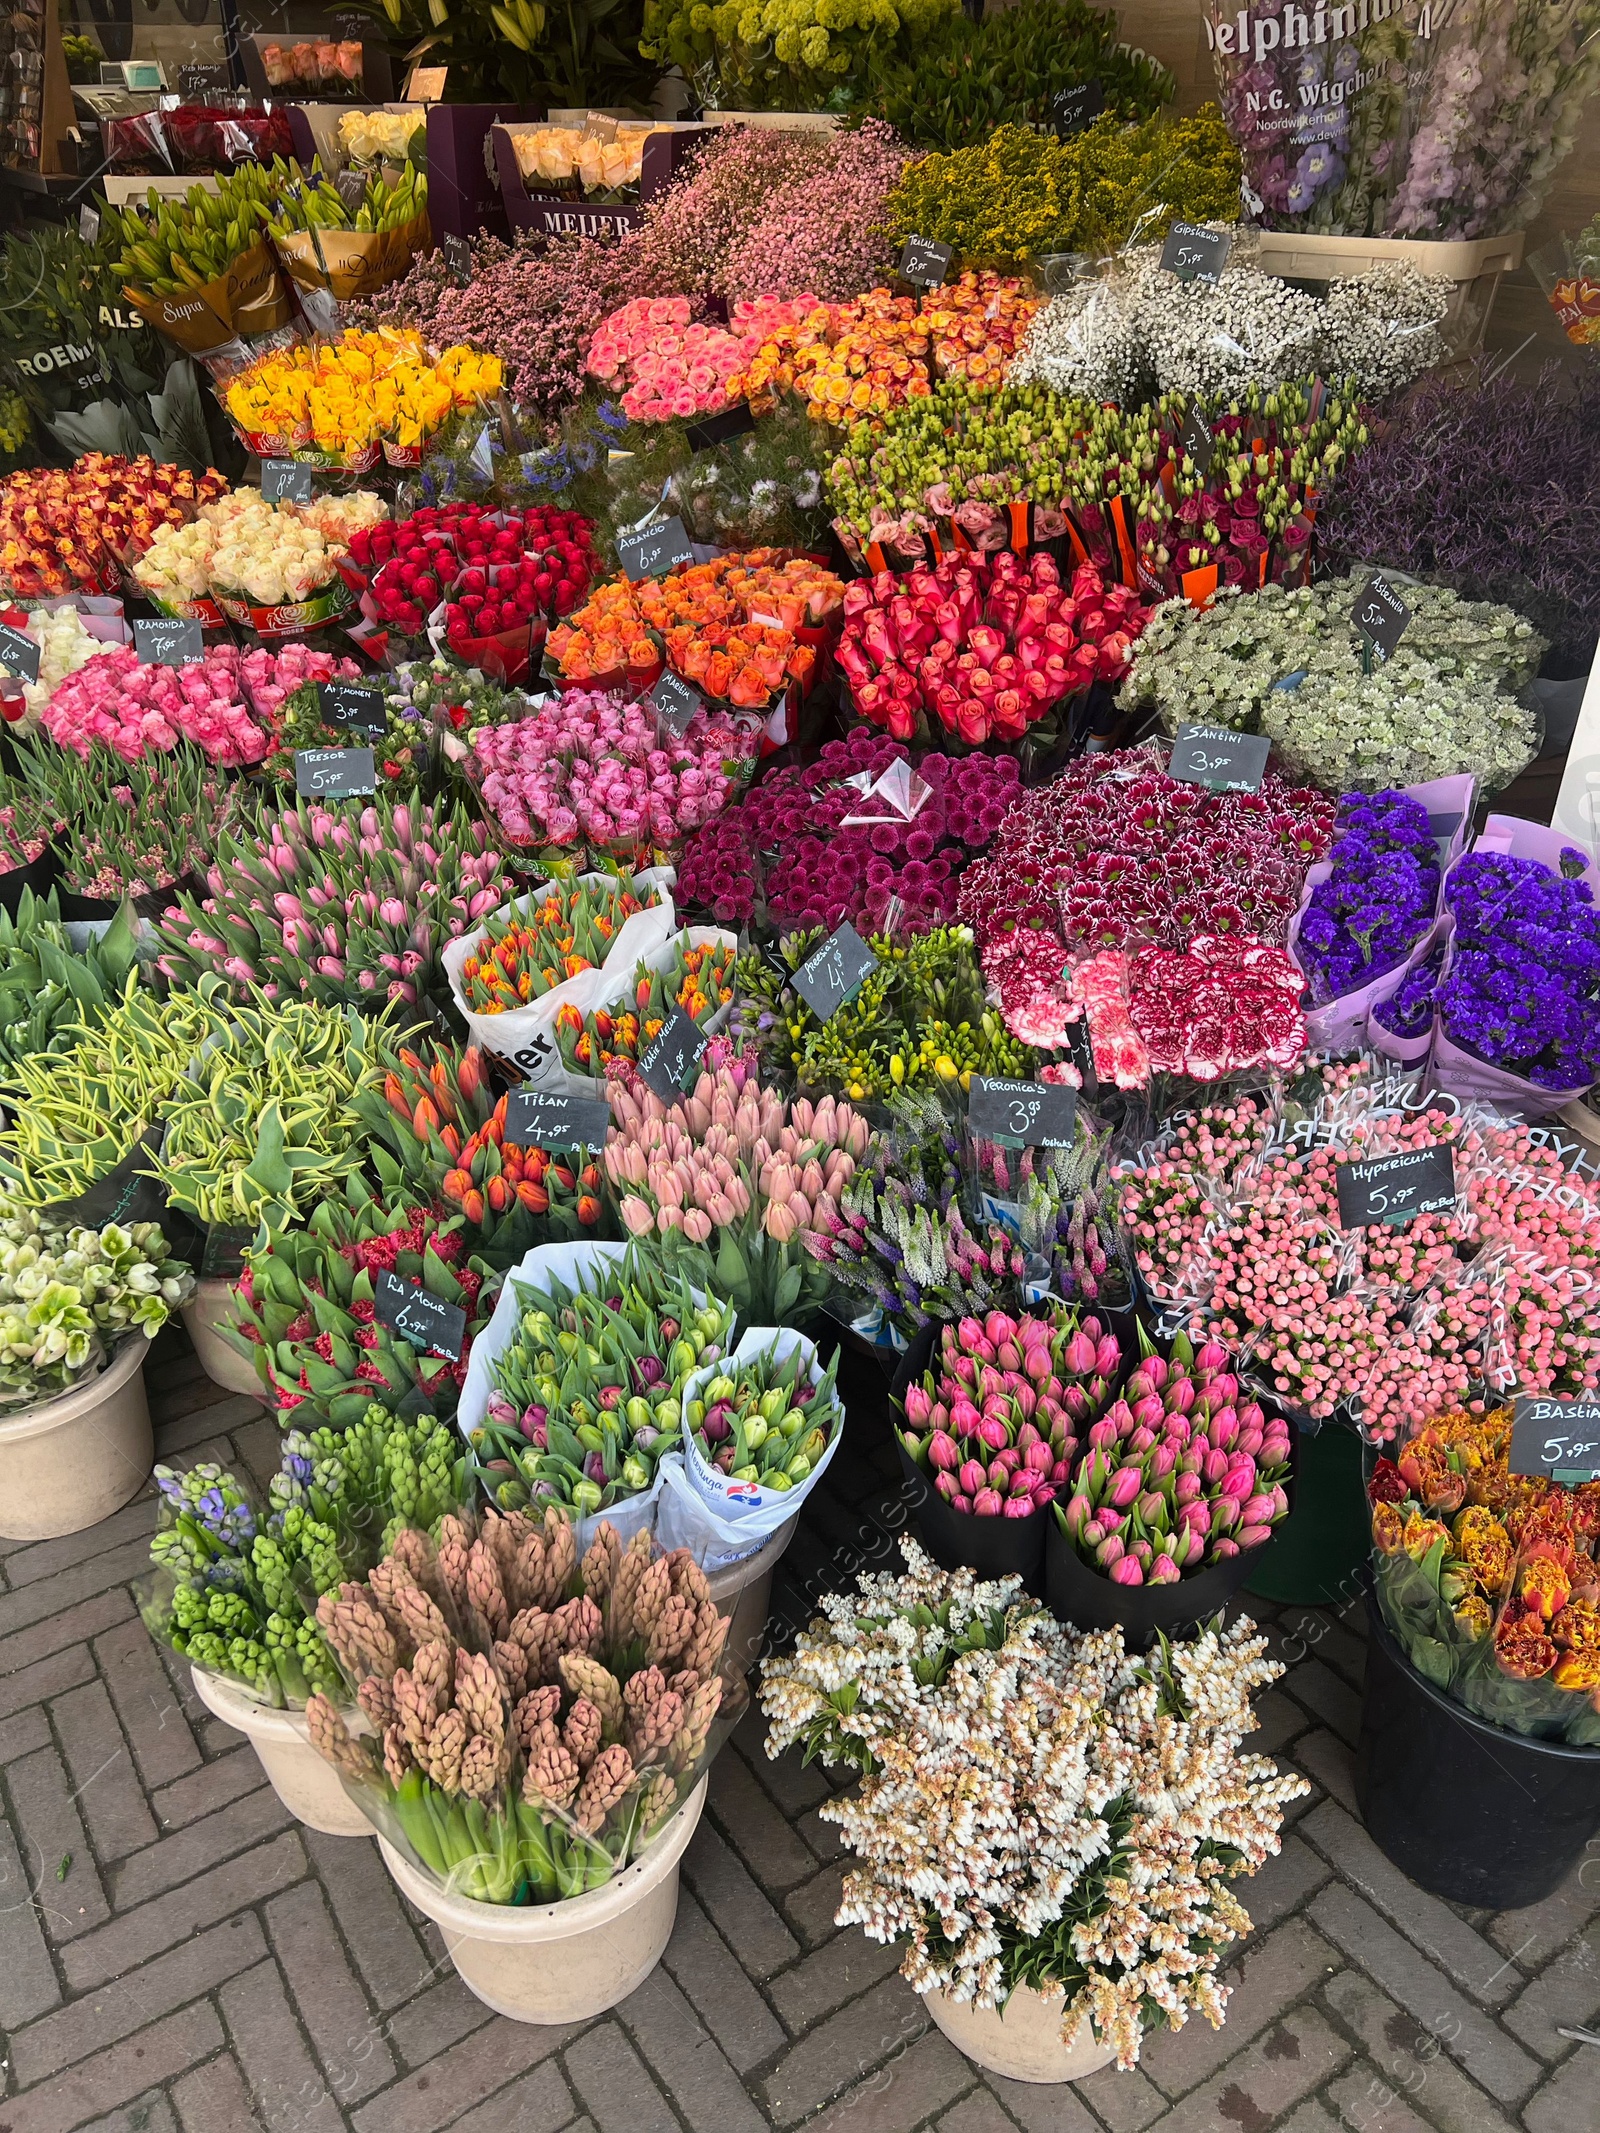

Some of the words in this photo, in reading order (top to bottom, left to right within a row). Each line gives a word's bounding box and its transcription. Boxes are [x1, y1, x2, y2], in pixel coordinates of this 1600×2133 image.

[542, 211, 631, 238] MEIJER
[1174, 247, 1204, 266] 5,95
[162, 300, 206, 324] Supra
[640, 547, 661, 570] 6,95
[136, 619, 186, 631] RAMONDA
[280, 627, 306, 636] ROSES
[150, 636, 177, 658] 7,95
[333, 702, 359, 720] 3,95
[298, 749, 347, 764] TRESOR
[1188, 750, 1232, 772] 3,95
[310, 769, 344, 789] 5,95
[524, 1115, 571, 1141] 4,95
[1366, 1184, 1418, 1215] 5,95
[395, 1304, 428, 1333] 6,95
[1541, 1436, 1599, 1462] 5,95
